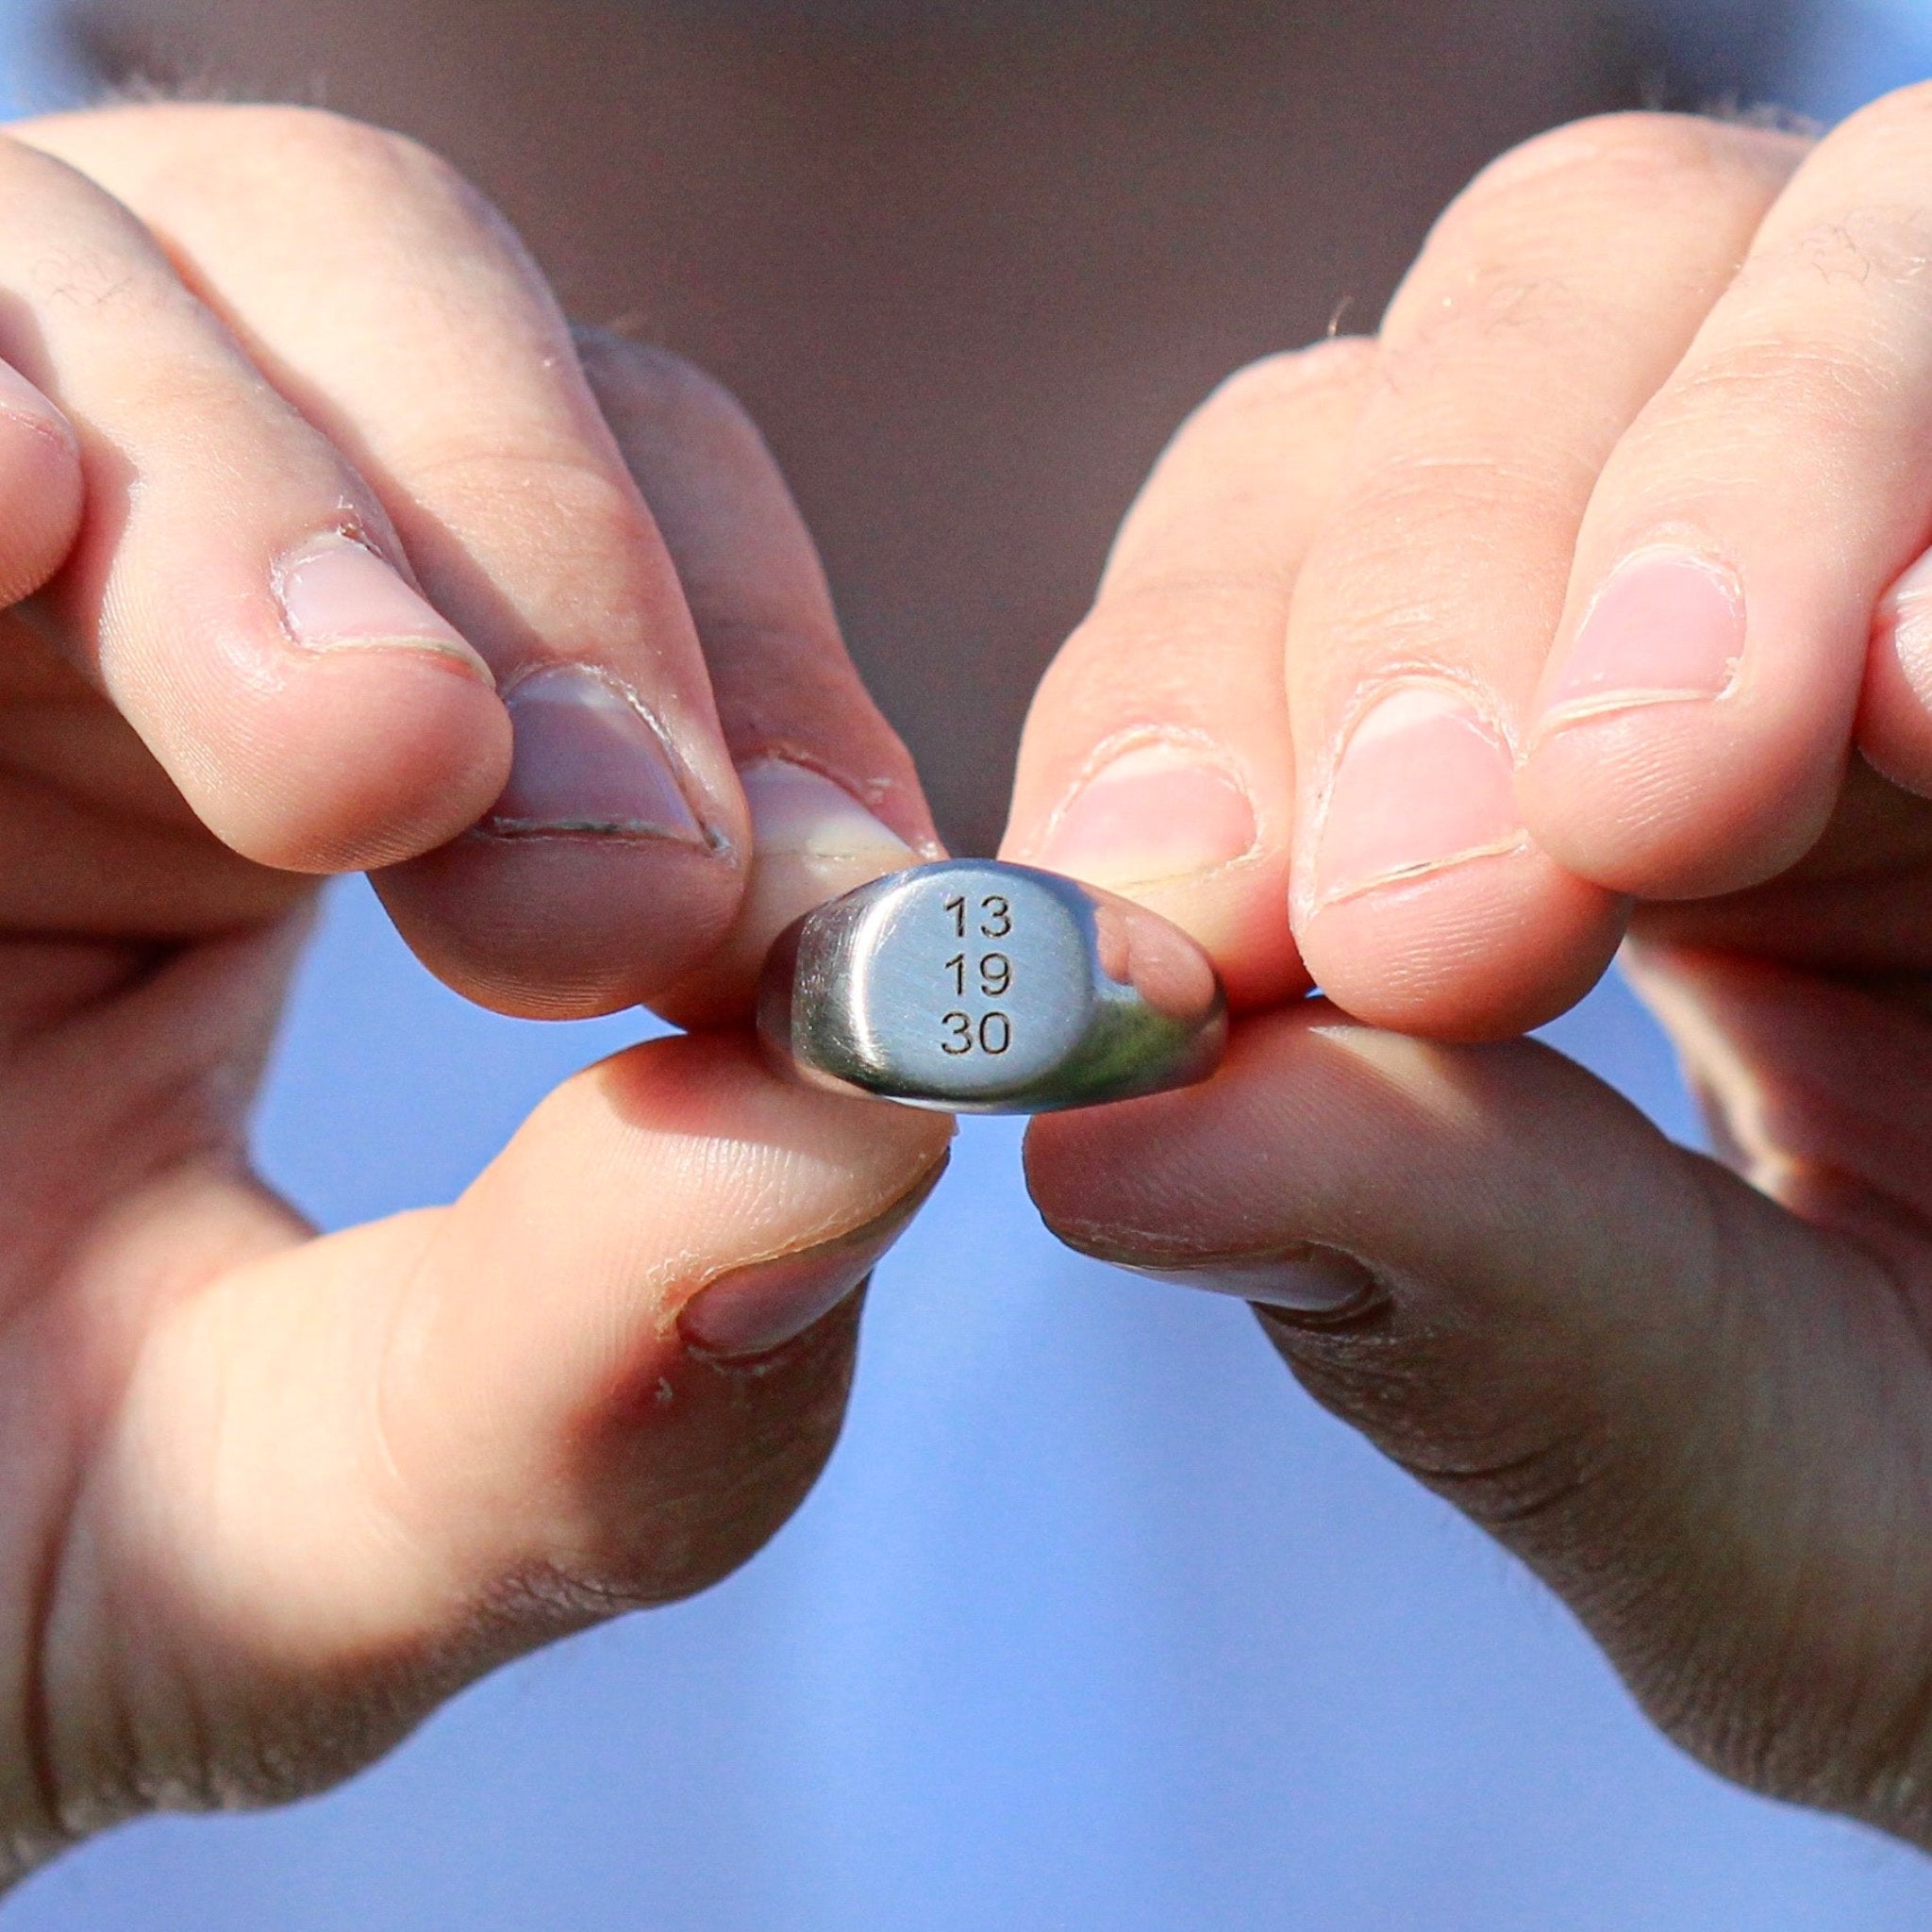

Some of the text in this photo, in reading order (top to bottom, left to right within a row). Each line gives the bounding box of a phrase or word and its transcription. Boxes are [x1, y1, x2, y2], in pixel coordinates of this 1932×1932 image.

[943, 895, 1012, 939] 13
[944, 953, 1012, 997] 19
[941, 1010, 1011, 1056] 30
